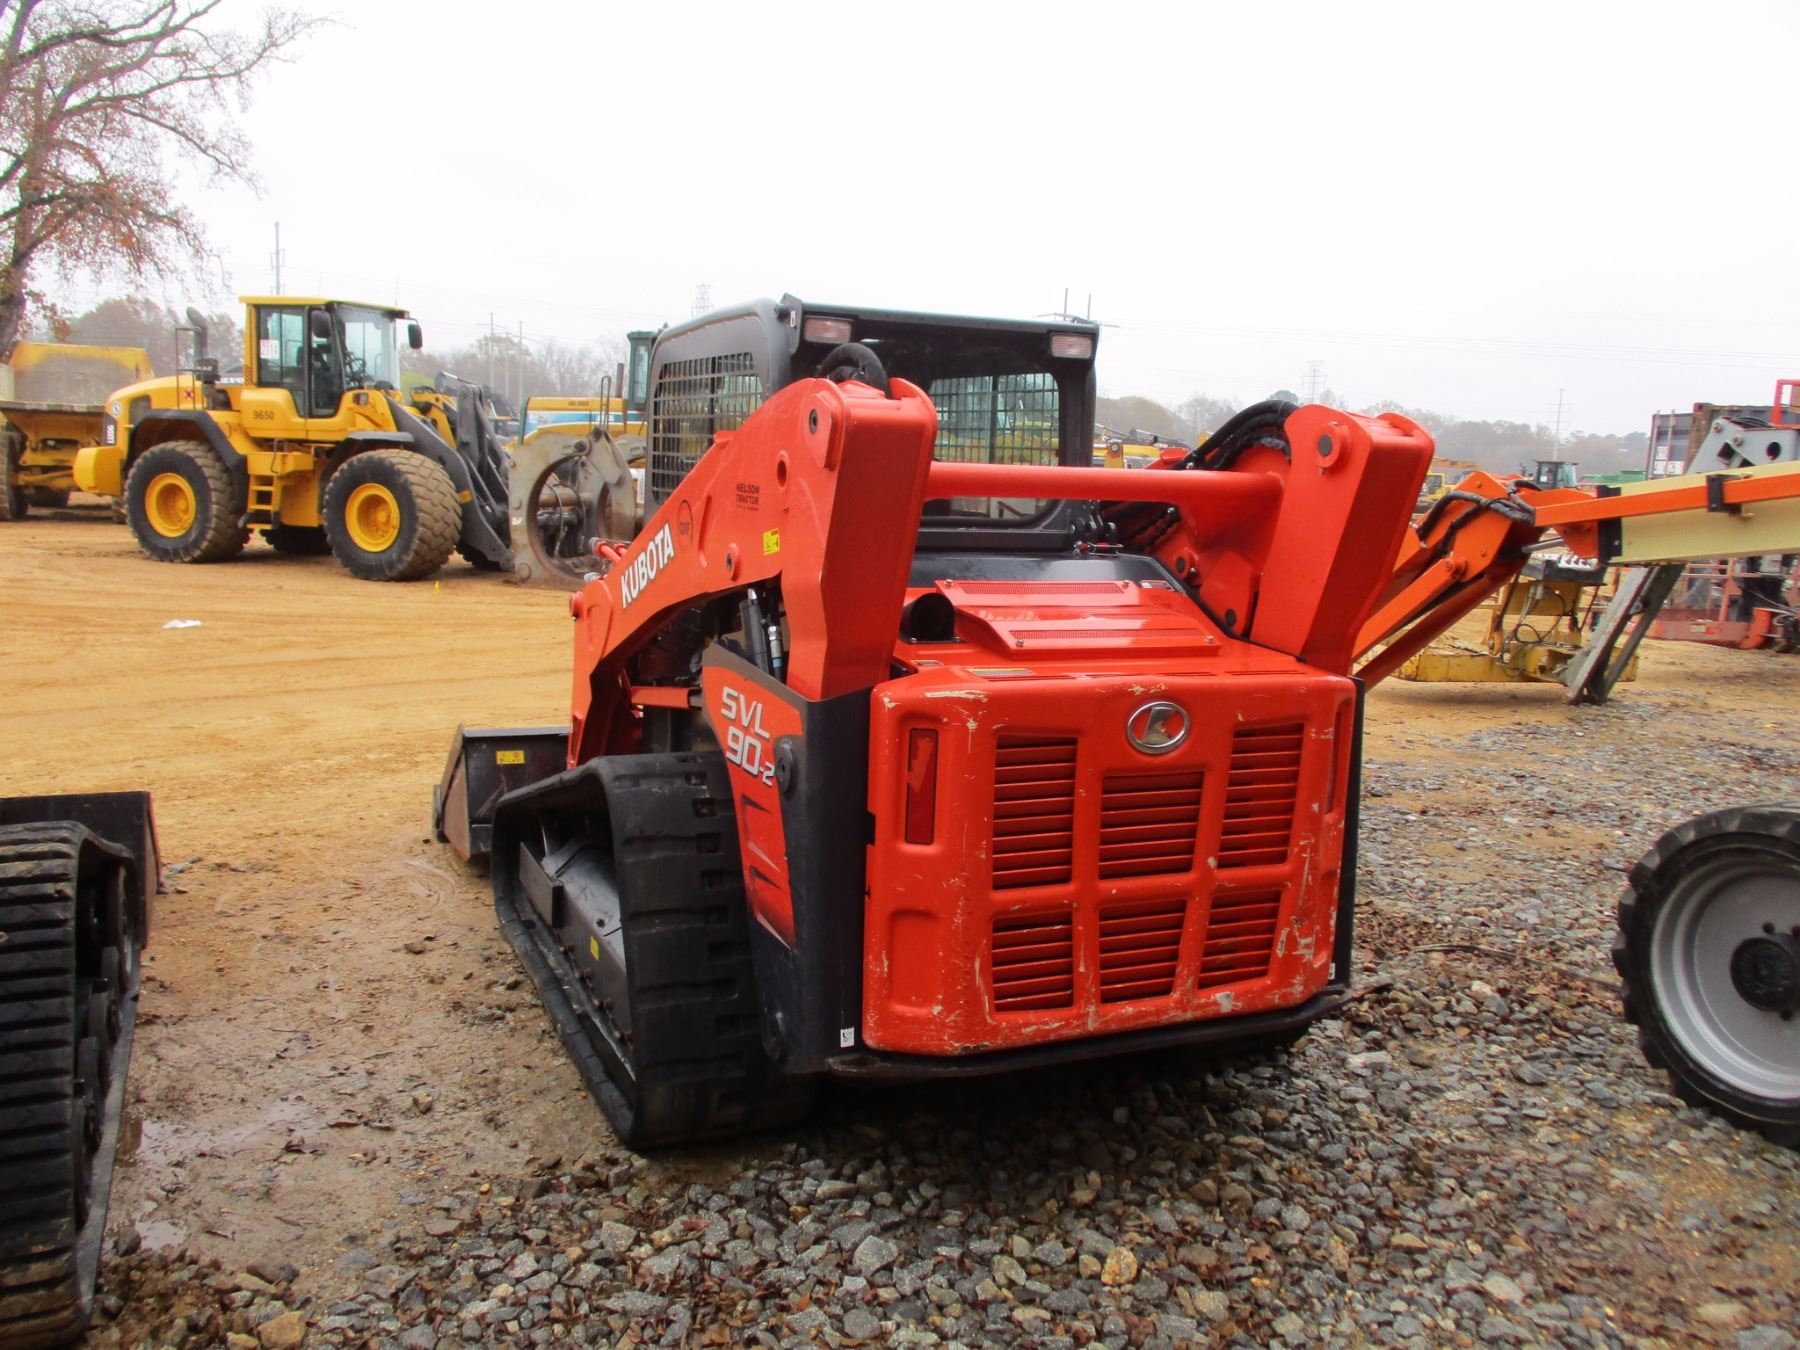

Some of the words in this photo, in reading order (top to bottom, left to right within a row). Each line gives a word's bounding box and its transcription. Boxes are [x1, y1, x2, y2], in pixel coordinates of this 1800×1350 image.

[736, 483, 760, 494] NELSON
[736, 494, 760, 505] TRACTOR
[621, 521, 675, 609] KUBOTA
[720, 686, 770, 740] SVL
